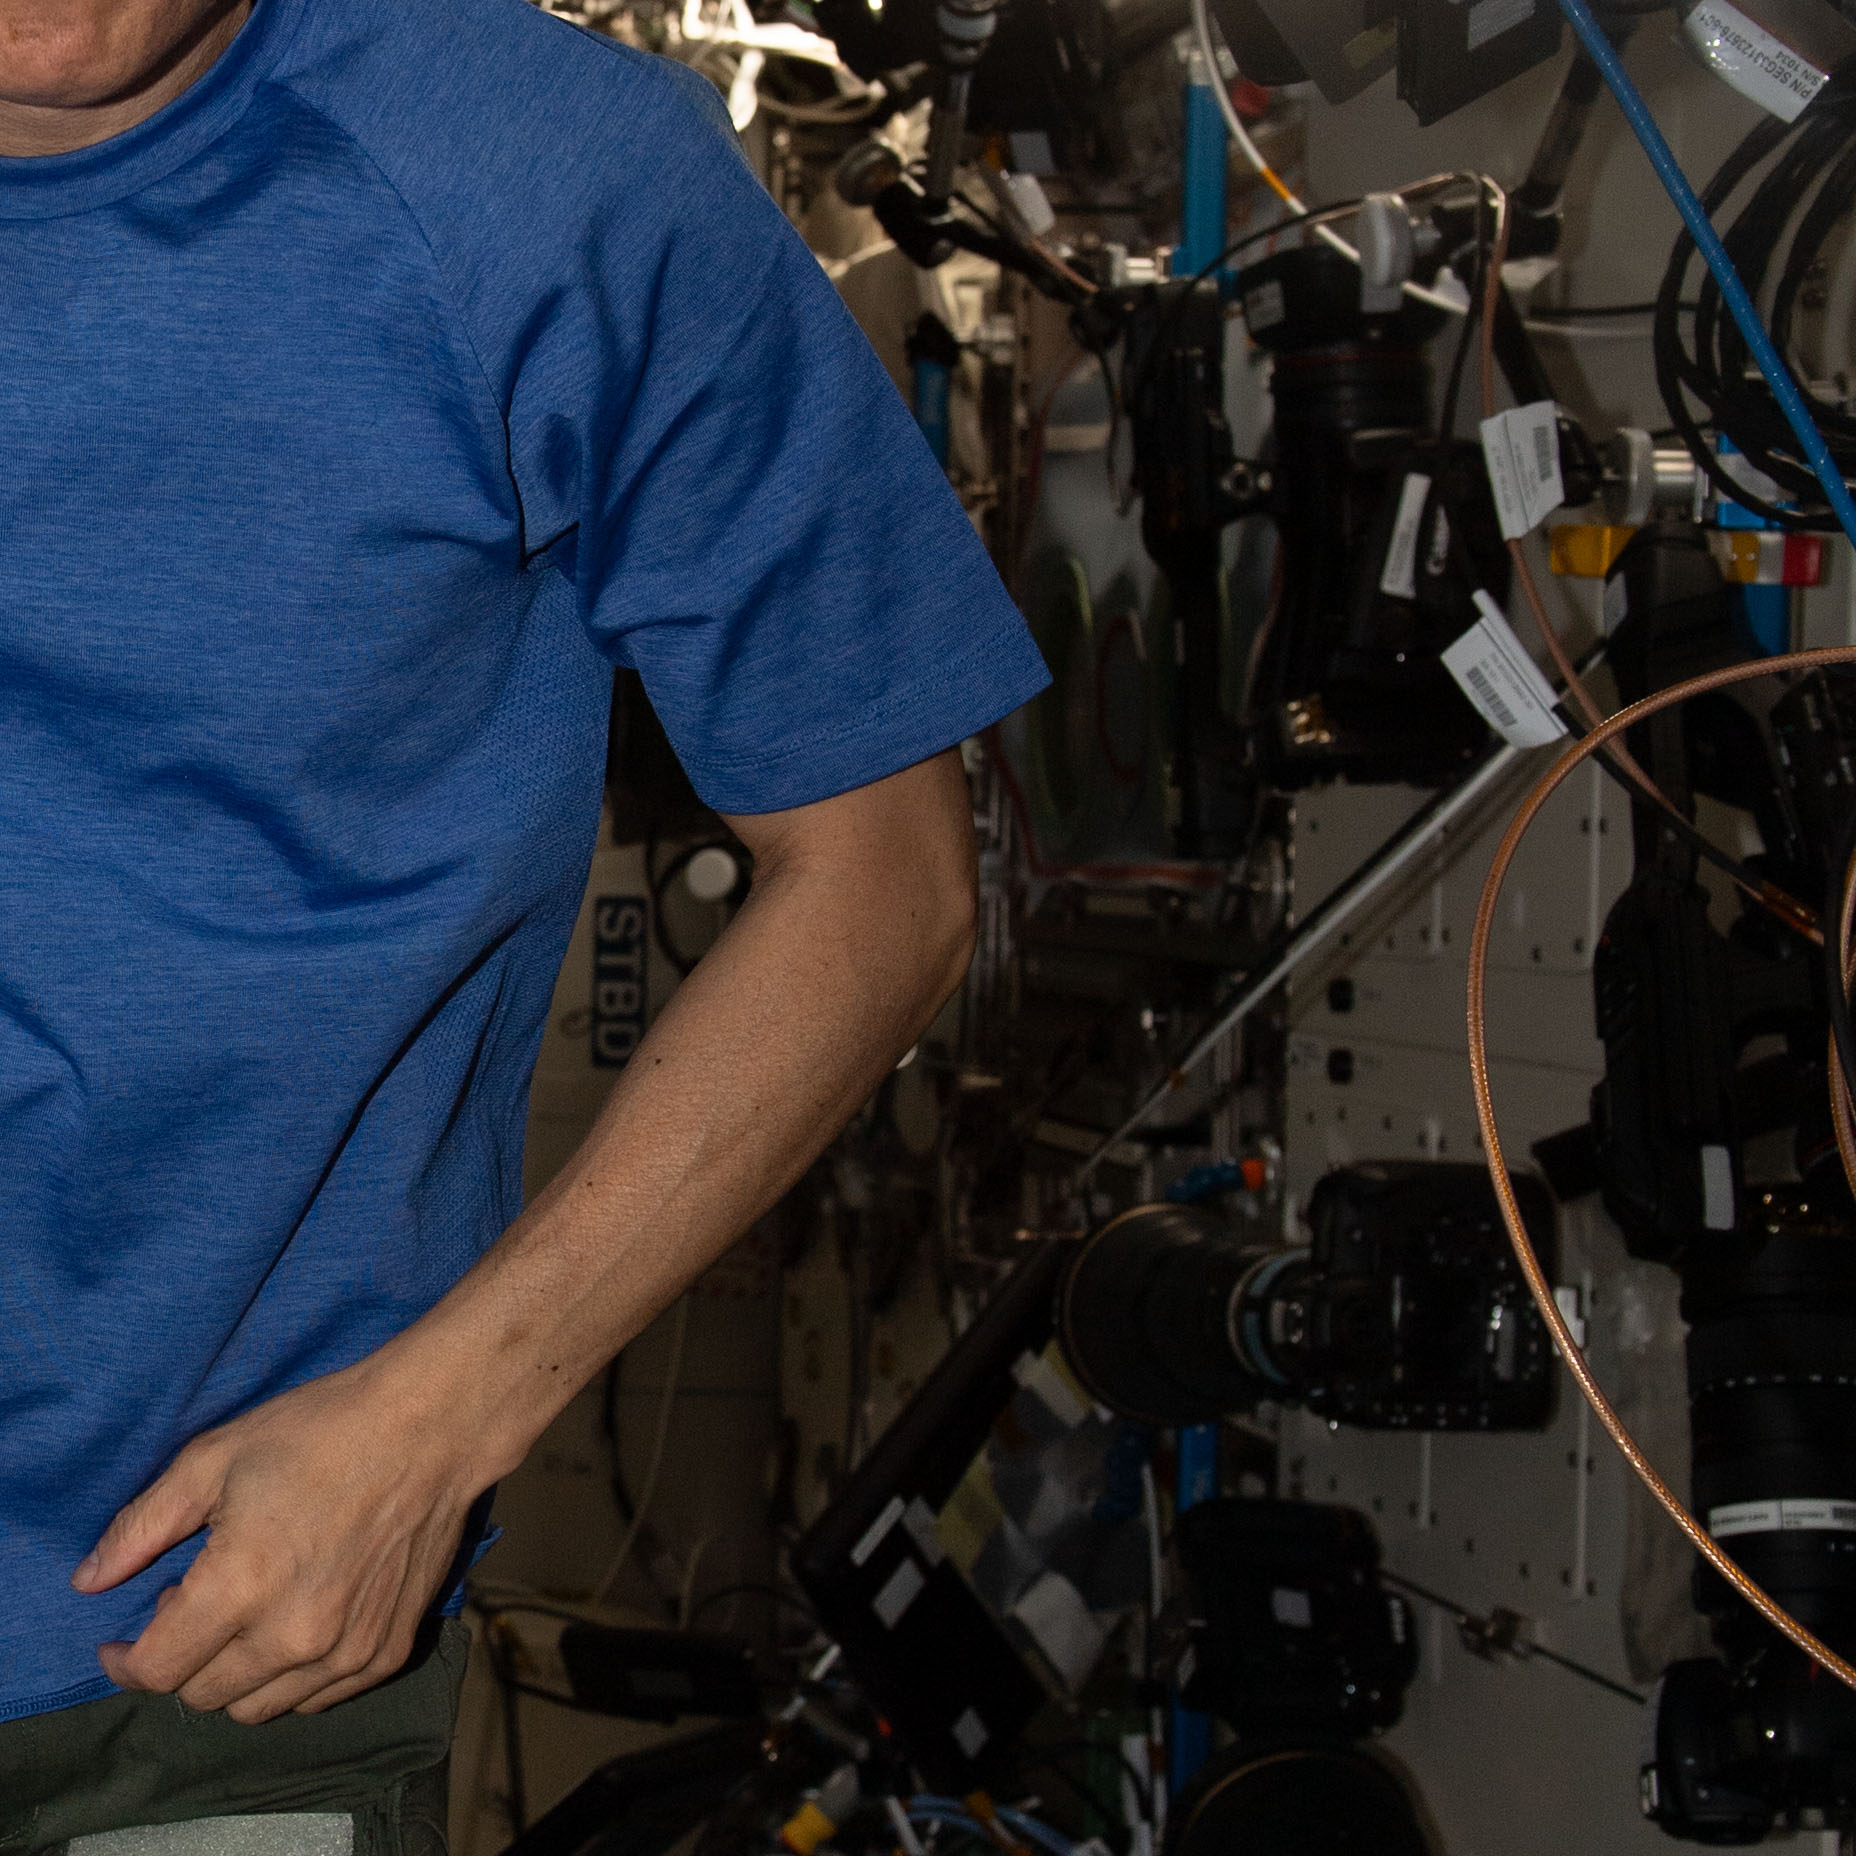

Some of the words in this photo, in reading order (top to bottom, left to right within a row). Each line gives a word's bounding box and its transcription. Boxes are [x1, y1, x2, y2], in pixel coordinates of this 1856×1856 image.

[1800, 69, 1820, 86] S/N
[1789, 78, 1813, 99] P/N
[597, 904, 643, 1059] STBD
